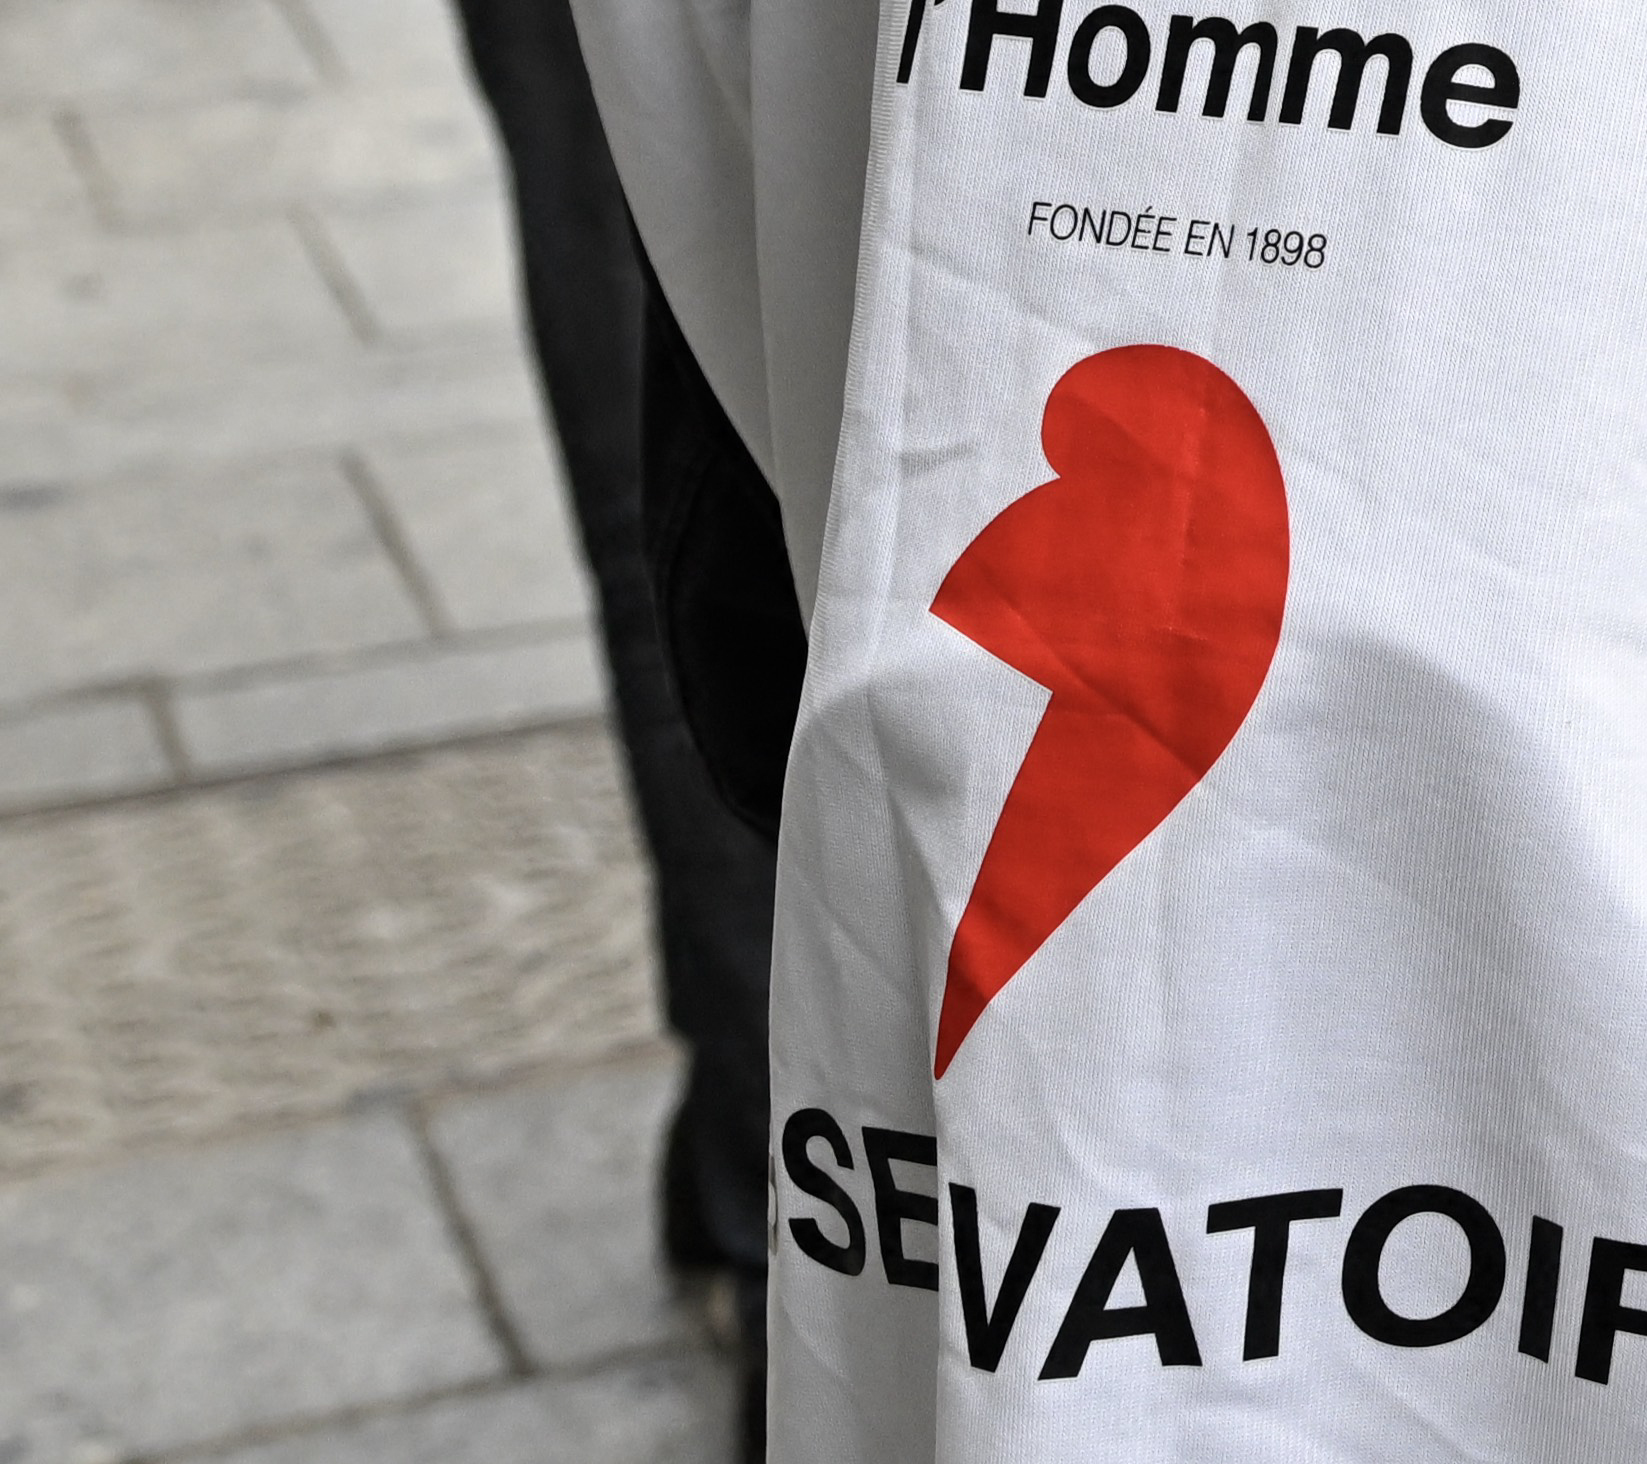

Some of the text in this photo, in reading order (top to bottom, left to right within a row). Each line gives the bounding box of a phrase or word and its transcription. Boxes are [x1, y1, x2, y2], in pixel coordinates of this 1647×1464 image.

[1027, 201, 1328, 269] FONDÉE EN 1898
